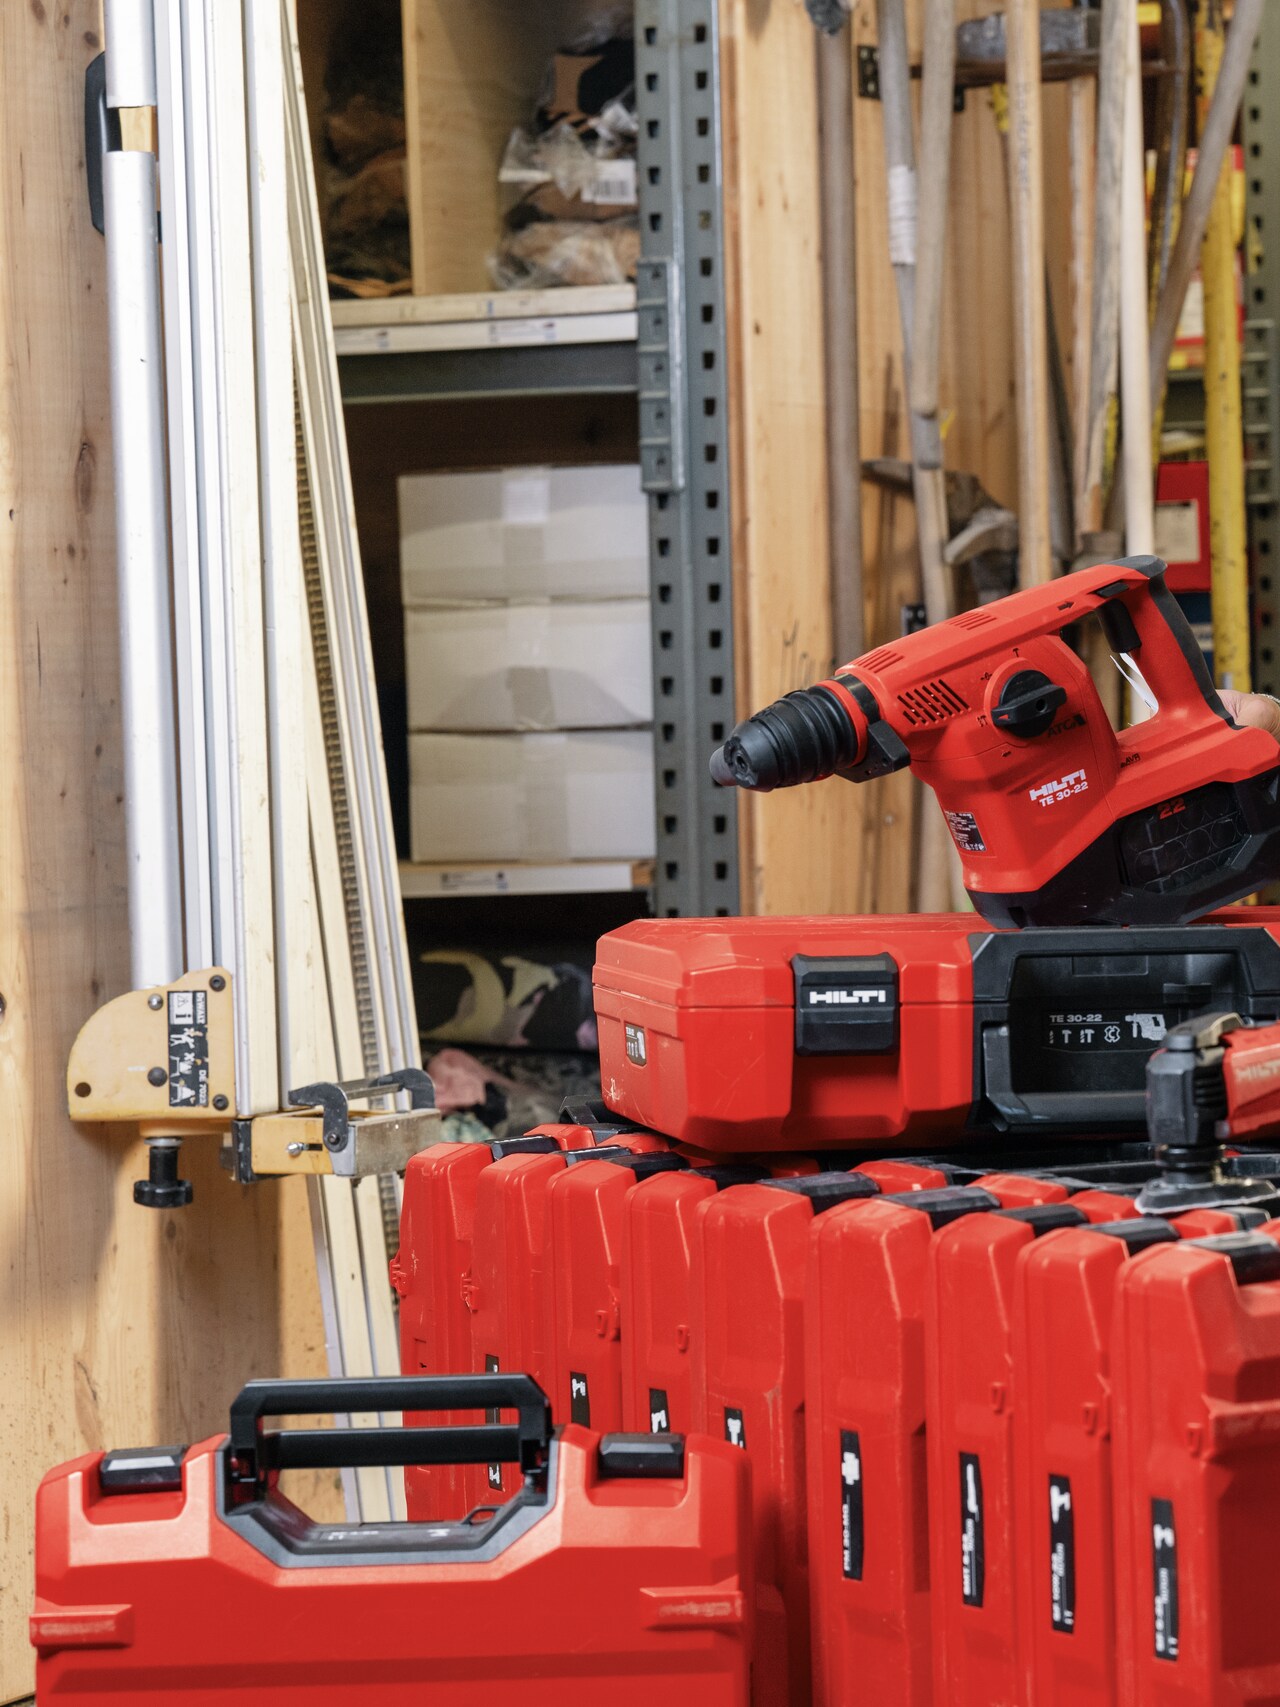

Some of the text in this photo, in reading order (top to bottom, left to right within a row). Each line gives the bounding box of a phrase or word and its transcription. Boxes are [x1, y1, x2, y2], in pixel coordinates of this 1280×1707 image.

[1029, 768, 1087, 801] HILTI
[1039, 781, 1089, 807] TE 30-22
[1157, 797, 1186, 820] 22
[809, 989, 886, 1004] HILTI
[1049, 1013, 1103, 1023] TE 30-22
